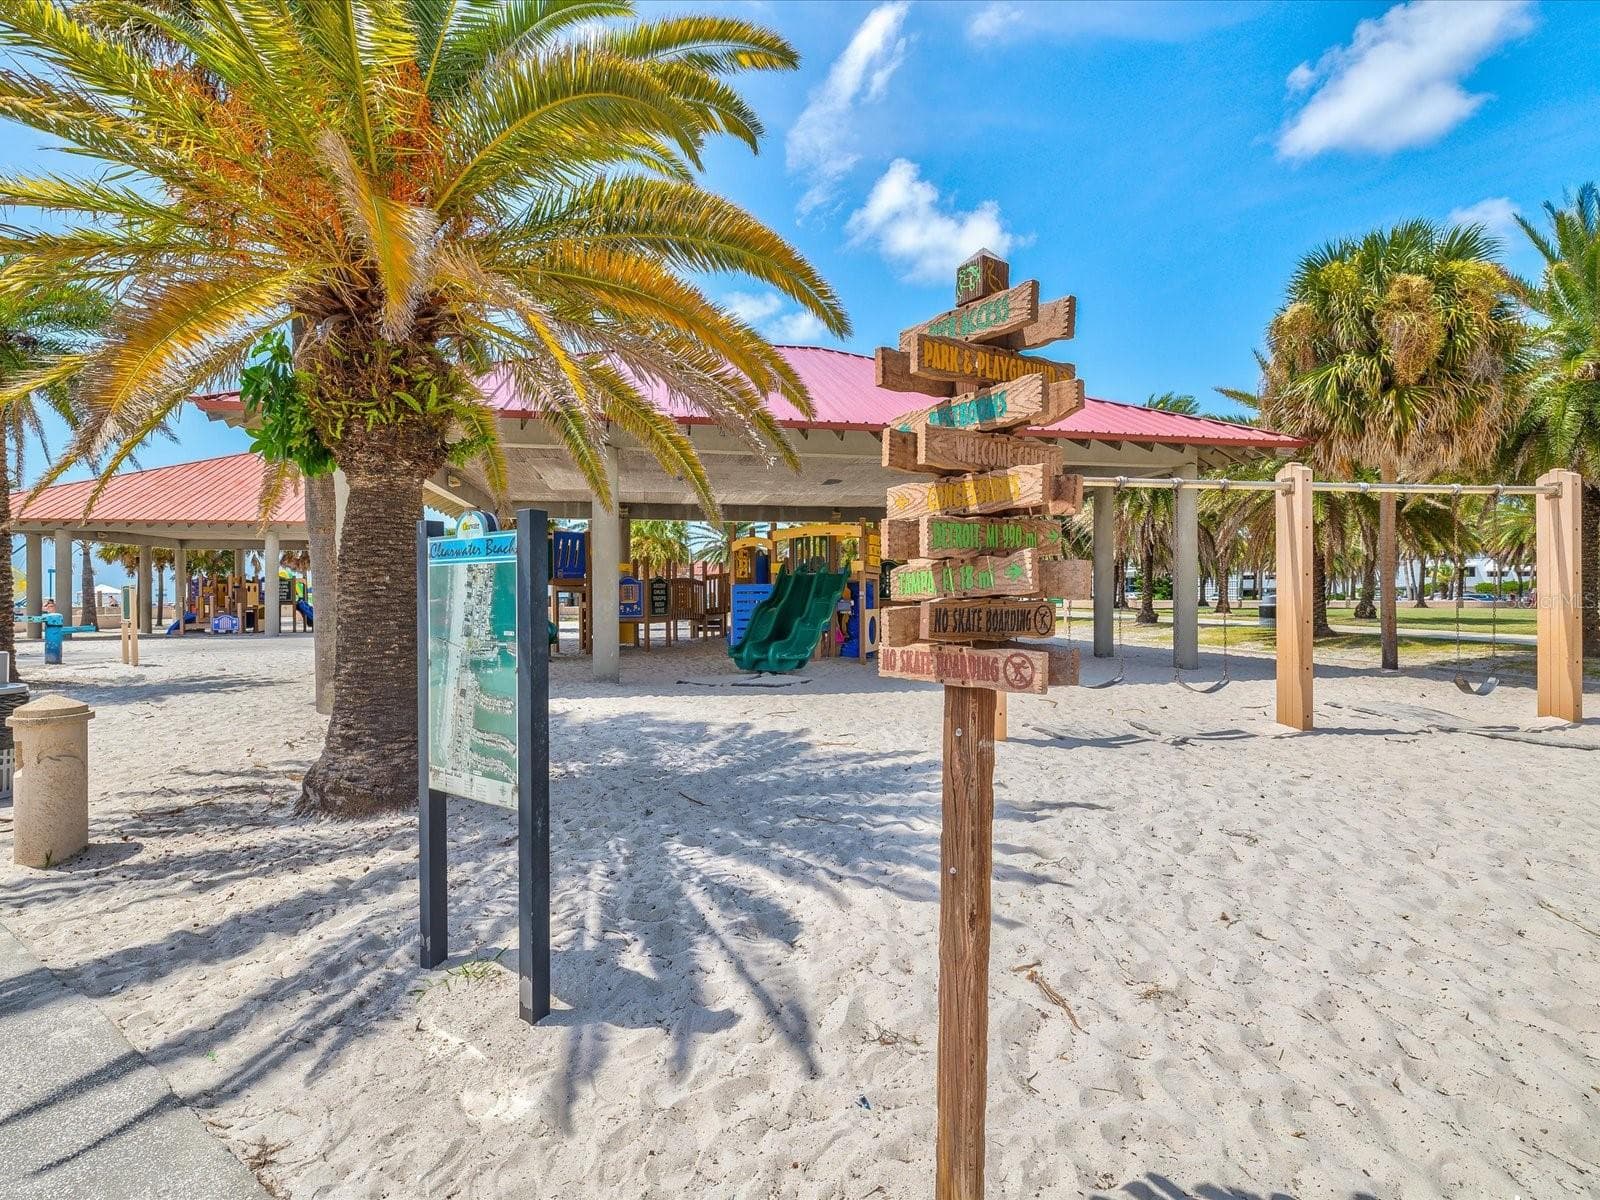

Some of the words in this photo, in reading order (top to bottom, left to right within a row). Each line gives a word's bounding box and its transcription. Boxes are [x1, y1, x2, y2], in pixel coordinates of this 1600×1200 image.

[961, 294, 1009, 336] ACCESS
[924, 341, 959, 373] PARK
[963, 355, 973, 374] &
[929, 389, 1008, 427] RESTROOMS
[955, 435, 1014, 469] WELCOME
[430, 541, 483, 559] Clearwater
[485, 536, 517, 556] Beach
[986, 523, 999, 548] MI
[1003, 523, 1023, 548] 990
[960, 564, 974, 590] 18
[934, 608, 948, 633] NO
[952, 607, 982, 633] SKATE
[986, 608, 1032, 633] BOARDING
[882, 648, 897, 672] NO
[899, 651, 934, 676] SKATE
[936, 653, 1000, 683] BOARDING
